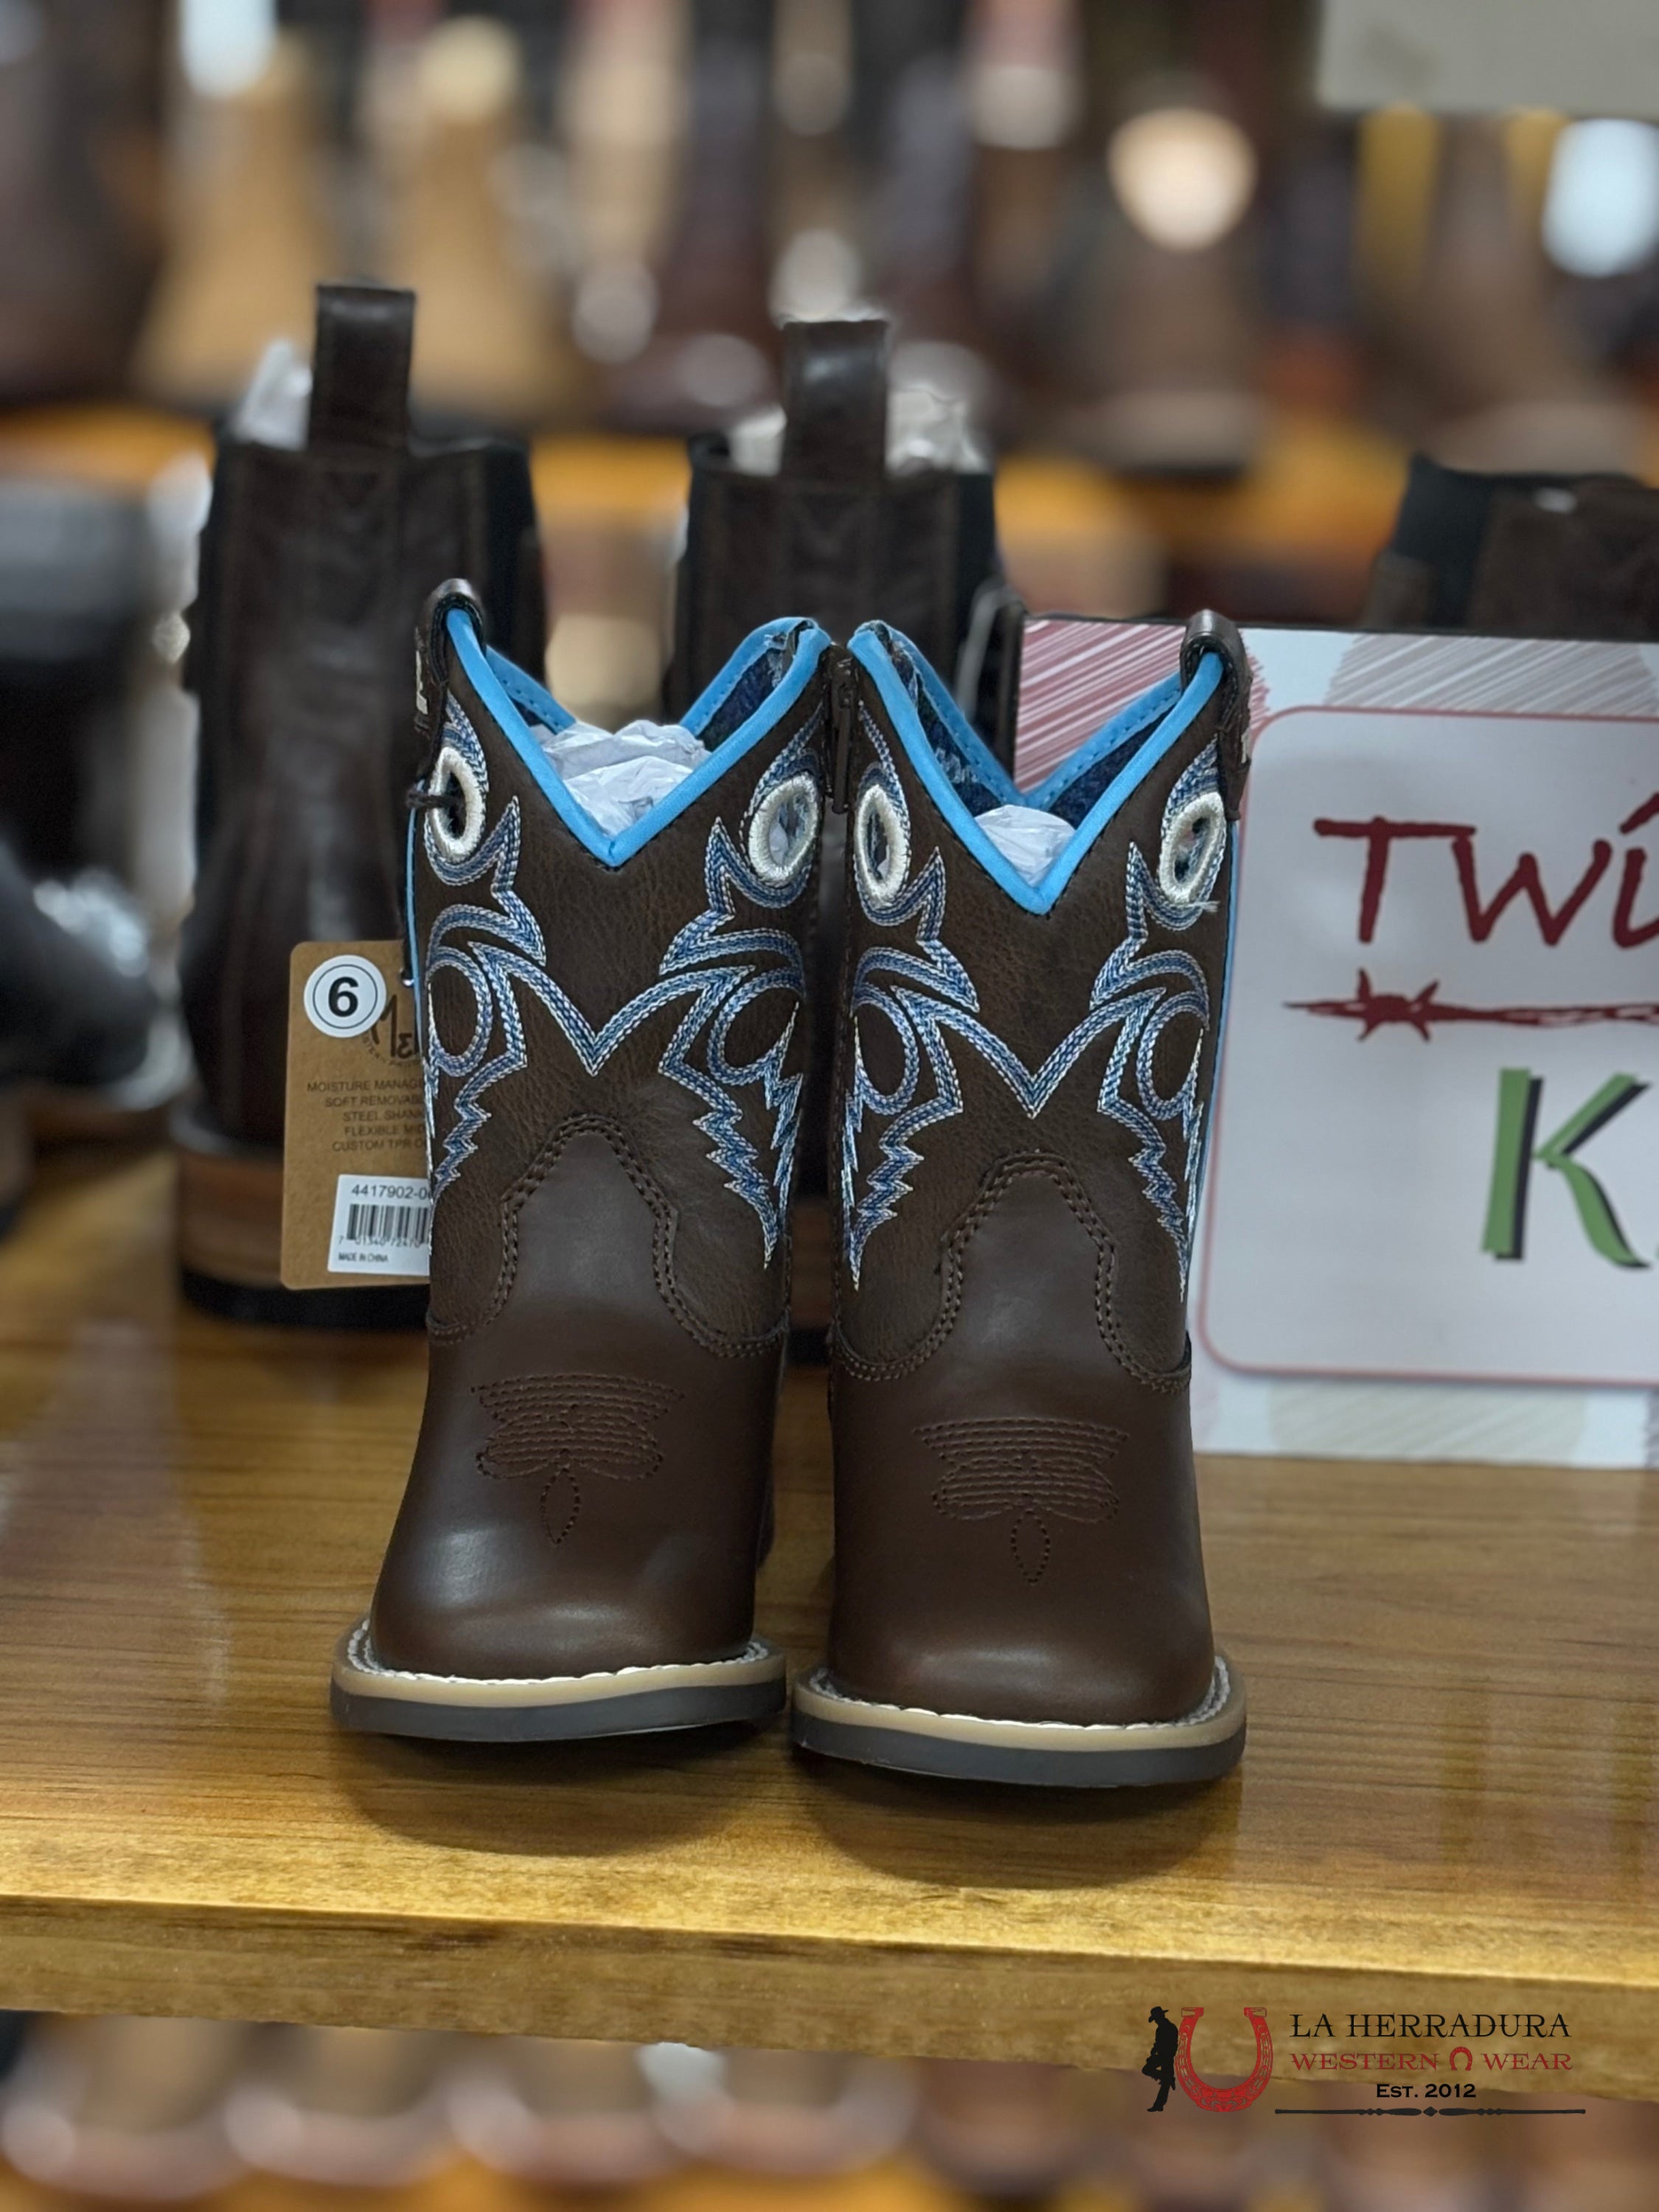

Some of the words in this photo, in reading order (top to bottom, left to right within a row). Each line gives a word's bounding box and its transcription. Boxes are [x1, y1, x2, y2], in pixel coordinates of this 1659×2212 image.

[328, 976, 359, 1018] 6
[307, 1080, 370, 1092] MOISTURE
[325, 1096, 356, 1107] SOFT
[343, 1110, 378, 1121] STEEL
[344, 1124, 397, 1136] FLEXIBLE
[333, 1140, 383, 1152] CUSTOM
[1481, 1068, 1659, 1271] K
[352, 1183, 431, 1200] 4417902-0
[338, 1252, 356, 1262] MADE
[359, 1252, 366, 1262] IN
[369, 1253, 389, 1262] CHINA
